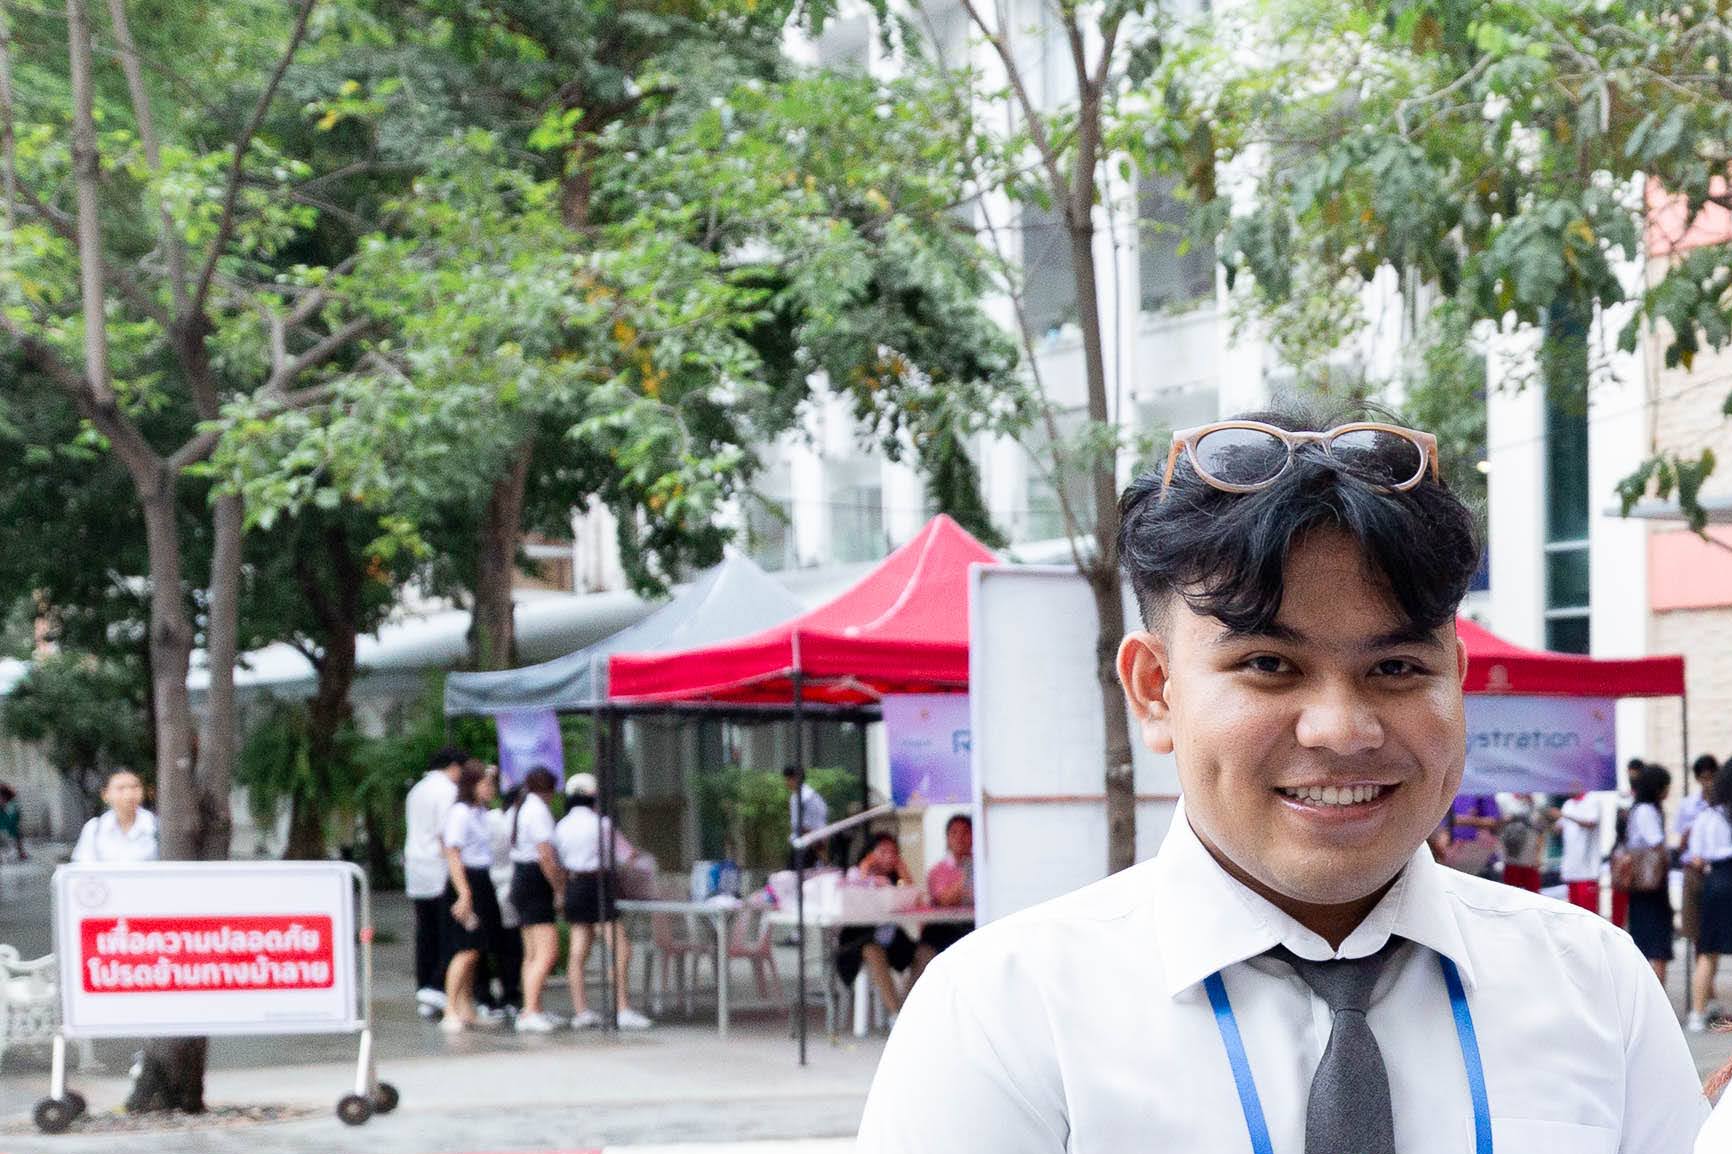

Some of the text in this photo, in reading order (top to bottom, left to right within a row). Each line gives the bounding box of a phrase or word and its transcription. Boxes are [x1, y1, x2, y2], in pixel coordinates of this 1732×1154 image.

[95, 918, 321, 954] เพื่อความปลอดภัย
[87, 955, 331, 987] โปรดข้ามทางม้าลาย
